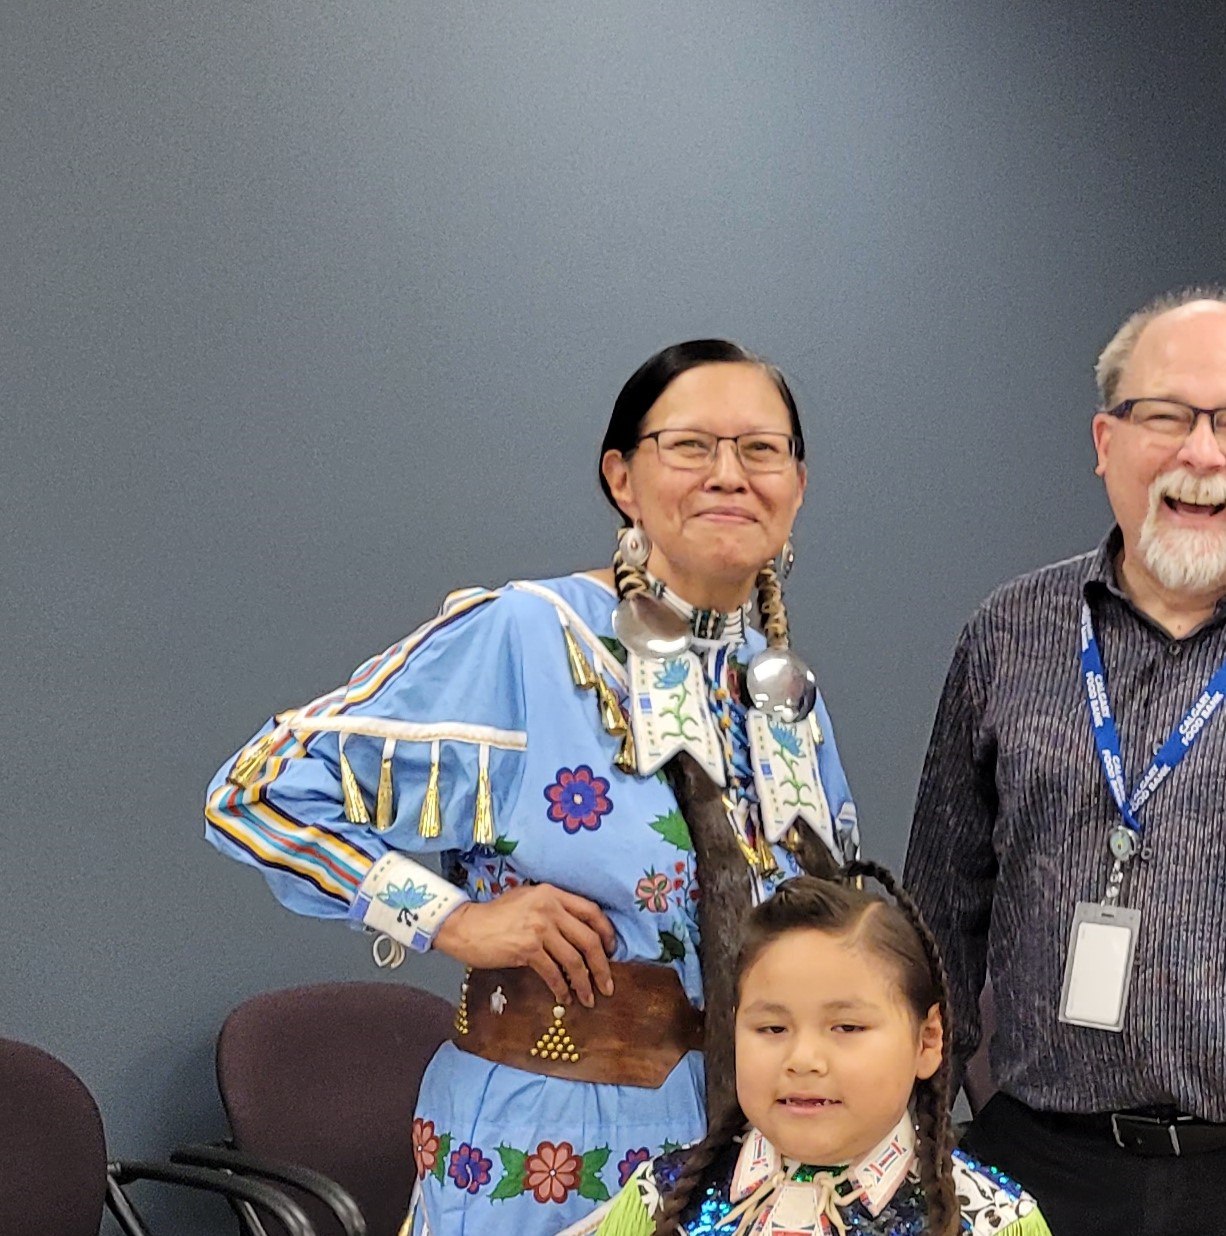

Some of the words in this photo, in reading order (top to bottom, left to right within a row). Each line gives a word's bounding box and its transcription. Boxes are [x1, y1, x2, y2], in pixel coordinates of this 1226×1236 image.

[1179, 690, 1211, 734] CALGARY
[1181, 717, 1204, 746] FOOD
[1201, 690, 1224, 719] BANK
